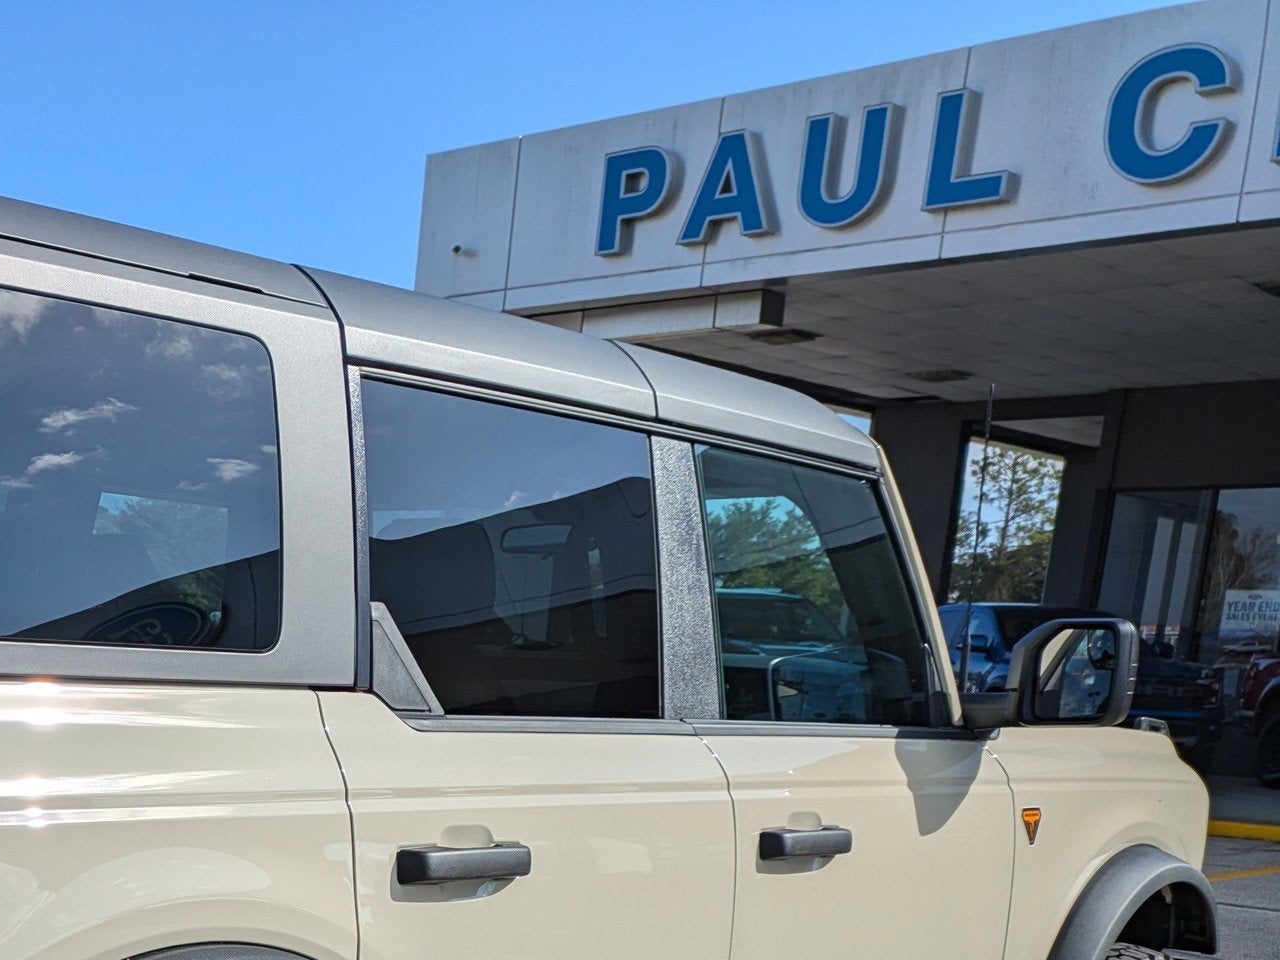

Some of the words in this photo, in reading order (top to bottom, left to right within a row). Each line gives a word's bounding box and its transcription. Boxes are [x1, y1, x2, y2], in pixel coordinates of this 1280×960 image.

[595, 88, 1018, 257] PAUL
[1104, 43, 1280, 185] C
[1227, 601, 1256, 611] YEAR
[1258, 601, 1280, 612] END
[1226, 612, 1251, 620] SALES
